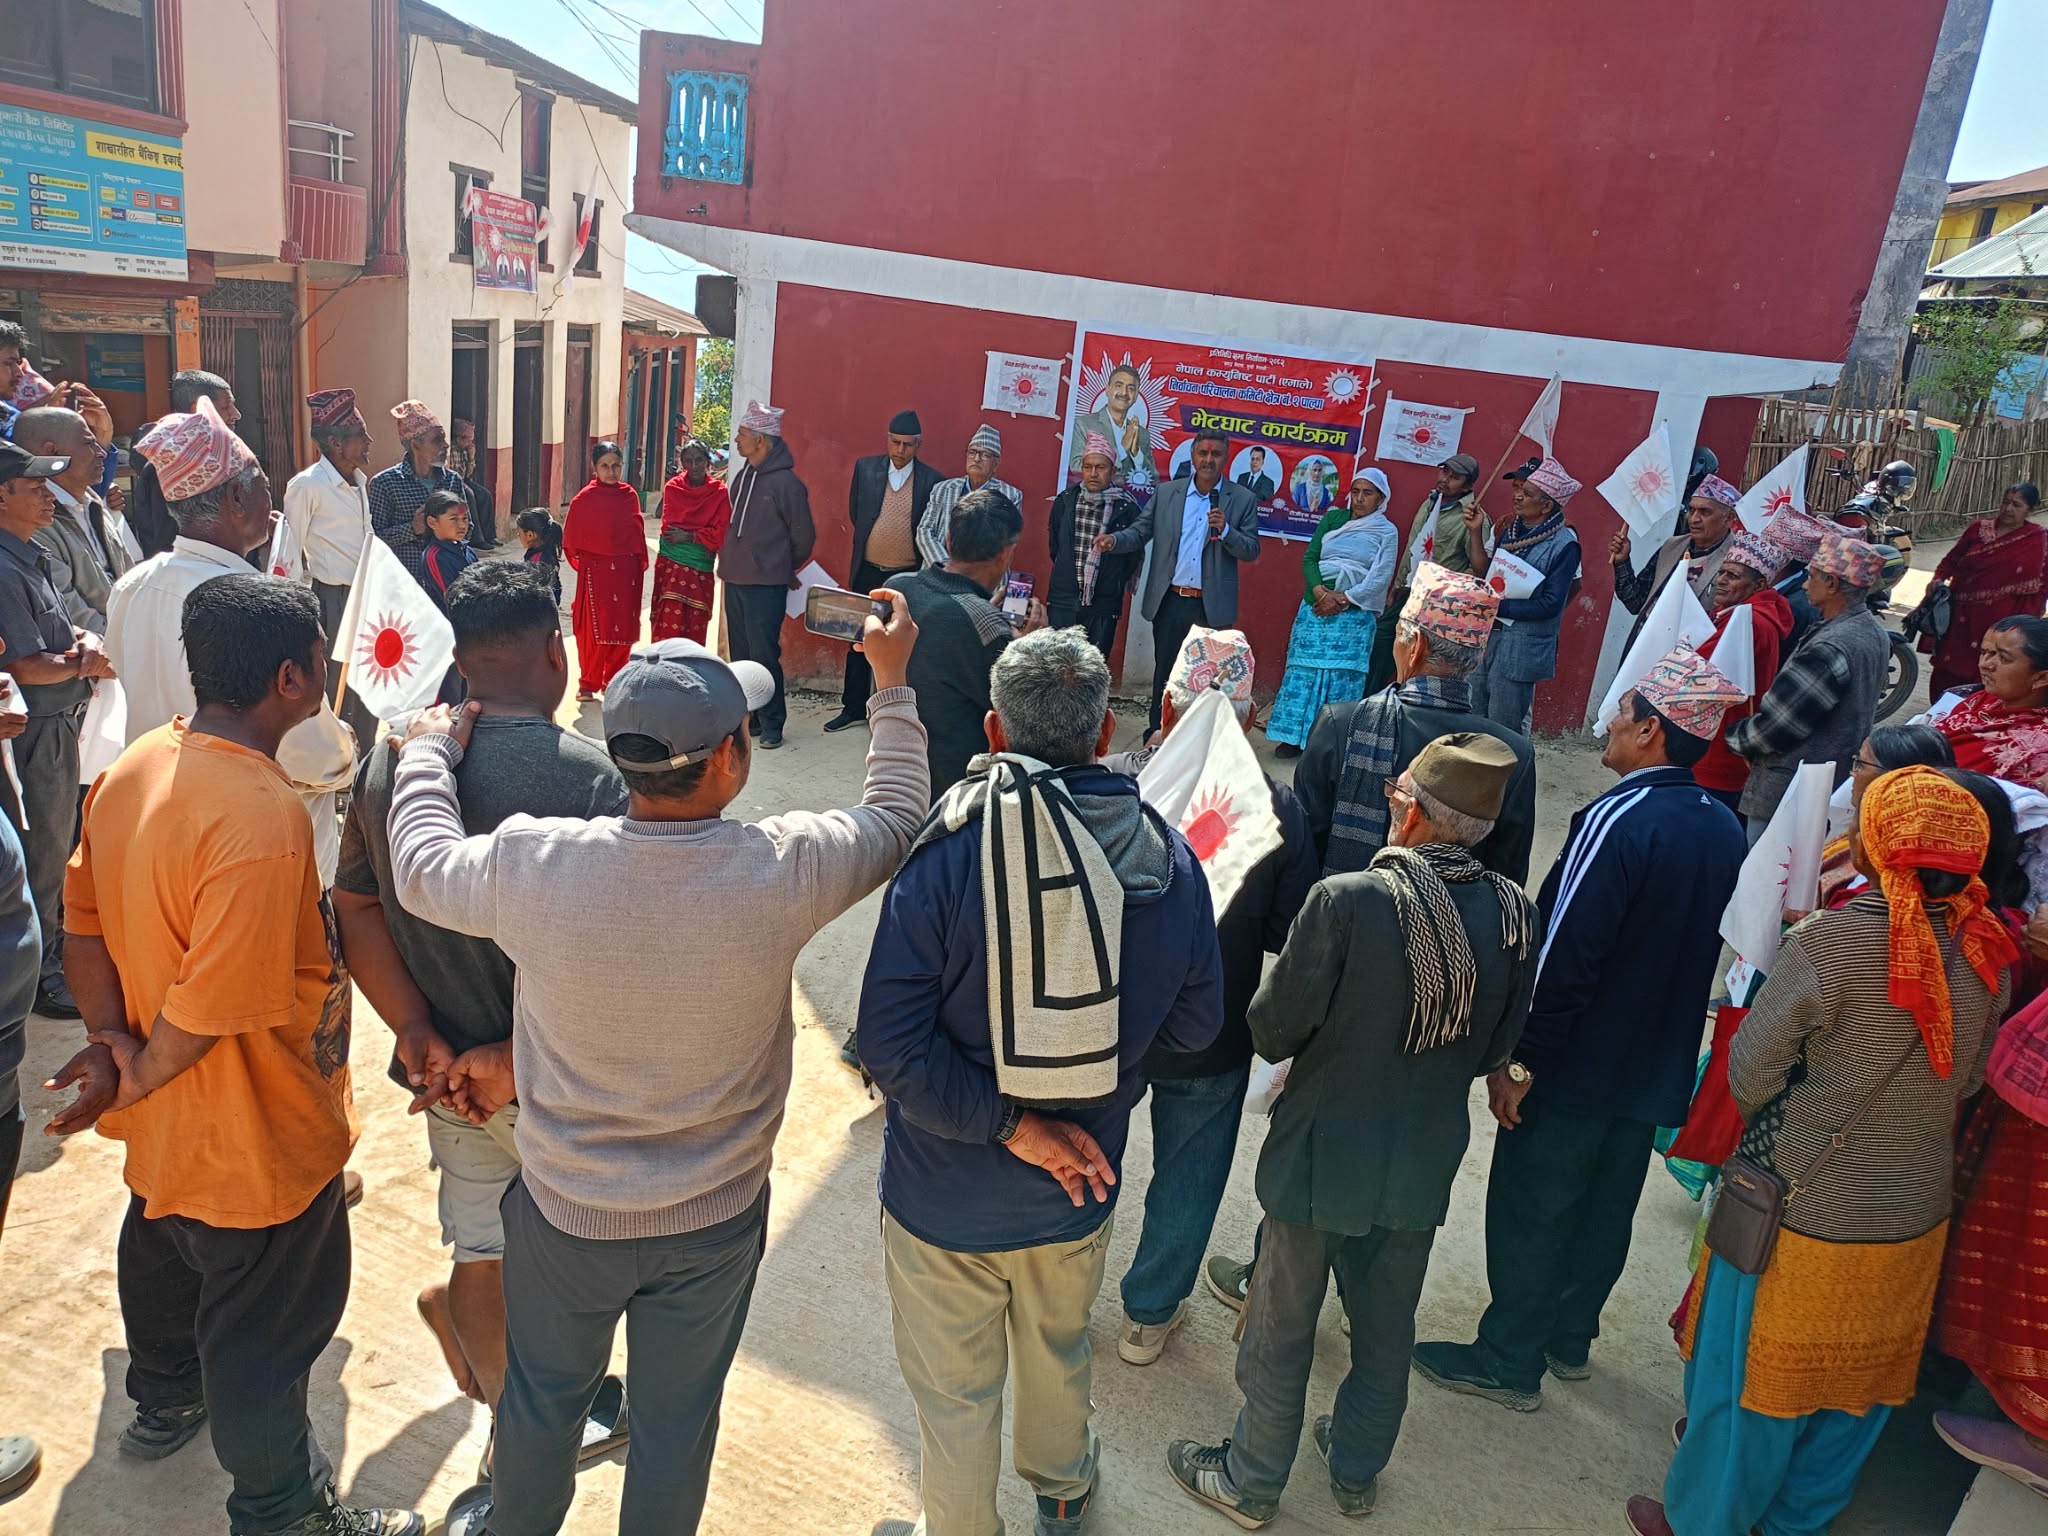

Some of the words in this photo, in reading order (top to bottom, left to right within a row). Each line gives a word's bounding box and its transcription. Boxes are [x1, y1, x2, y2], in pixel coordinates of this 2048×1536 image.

[96, 141, 135, 159] शाखारहित
[1176, 362, 1203, 376] नेपाल
[1255, 374, 1276, 385] पार्टी
[1278, 377, 1313, 390] (एमाले)
[1169, 377, 1200, 393] निर्वाचन
[1200, 381, 1236, 399] परिचालन
[1237, 385, 1264, 402] कमिटी
[1301, 396, 1325, 411] पाल्पा
[1191, 408, 1256, 434] भेटघाट
[1260, 421, 1349, 447] कार्यक्रम
